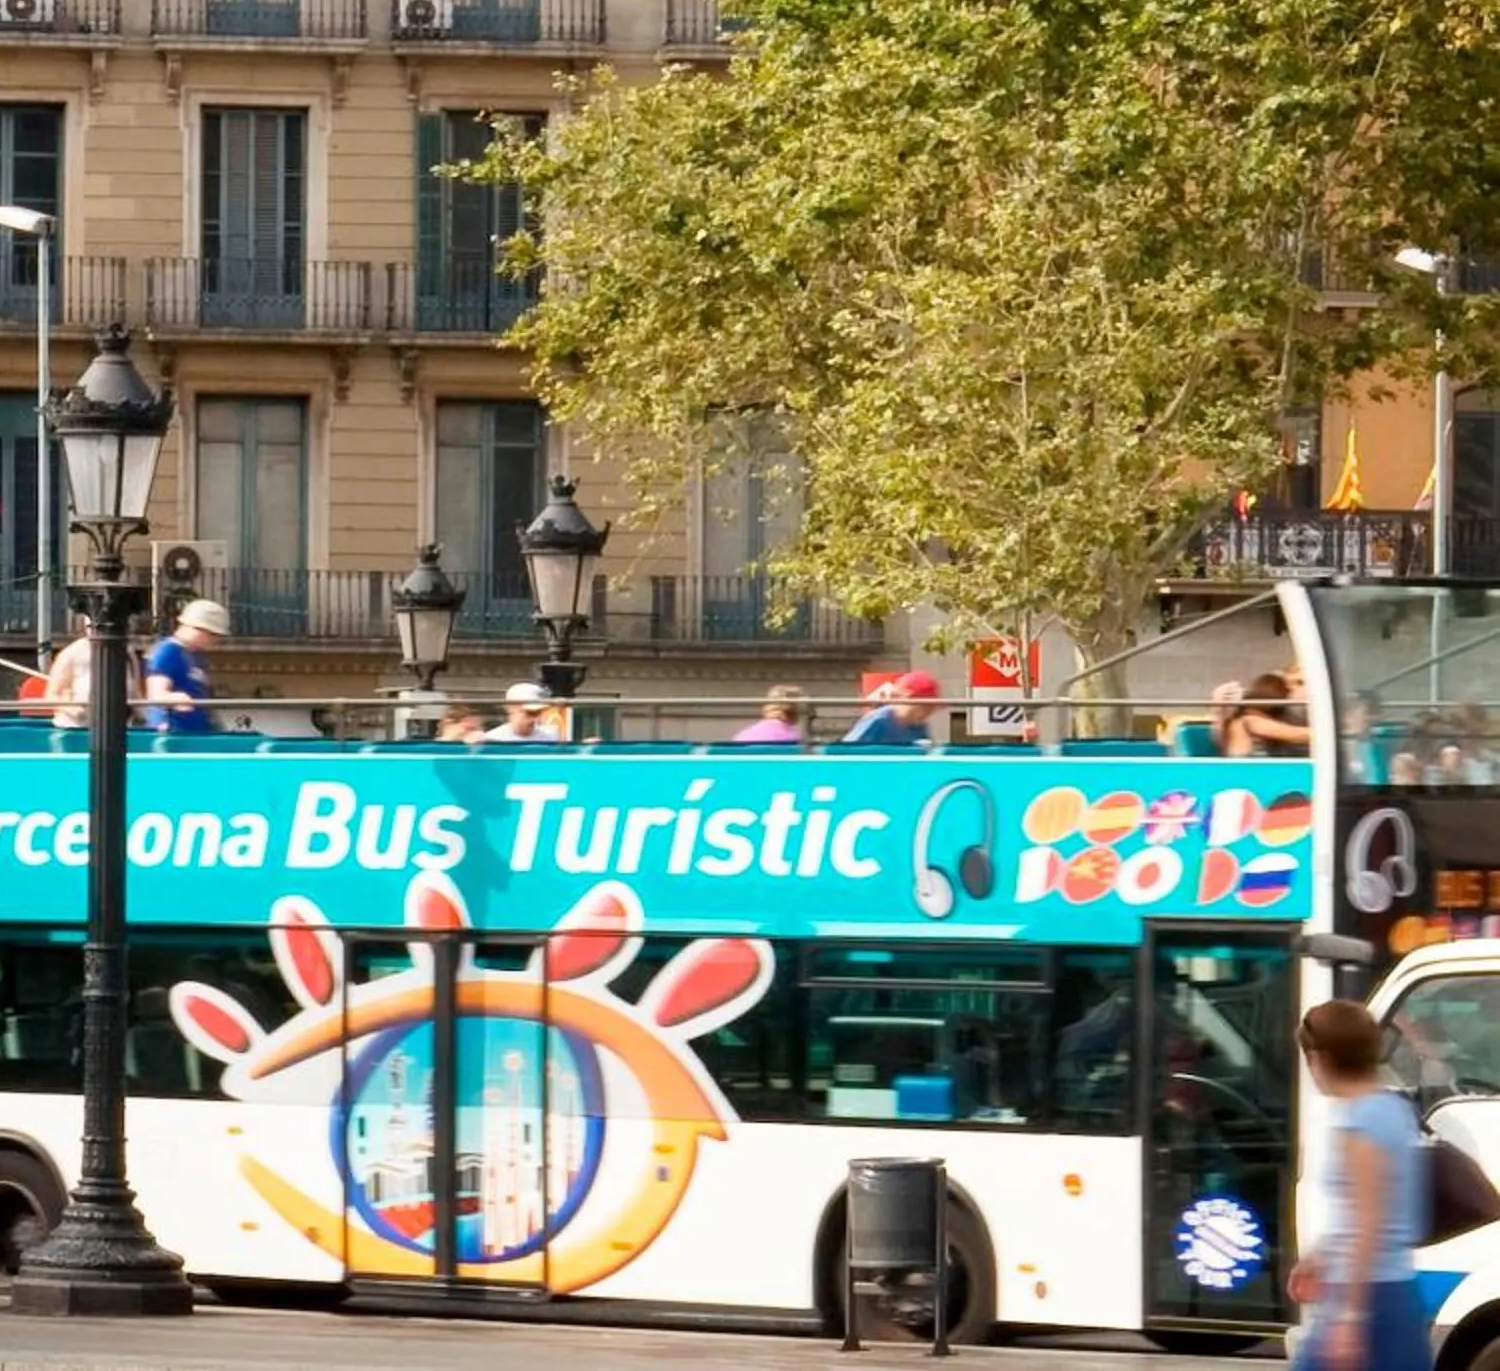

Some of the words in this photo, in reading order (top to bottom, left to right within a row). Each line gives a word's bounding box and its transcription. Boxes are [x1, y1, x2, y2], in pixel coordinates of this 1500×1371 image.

[1000, 652, 1017, 668] M
[286, 781, 469, 872] Bus
[504, 778, 891, 879] Turístic
